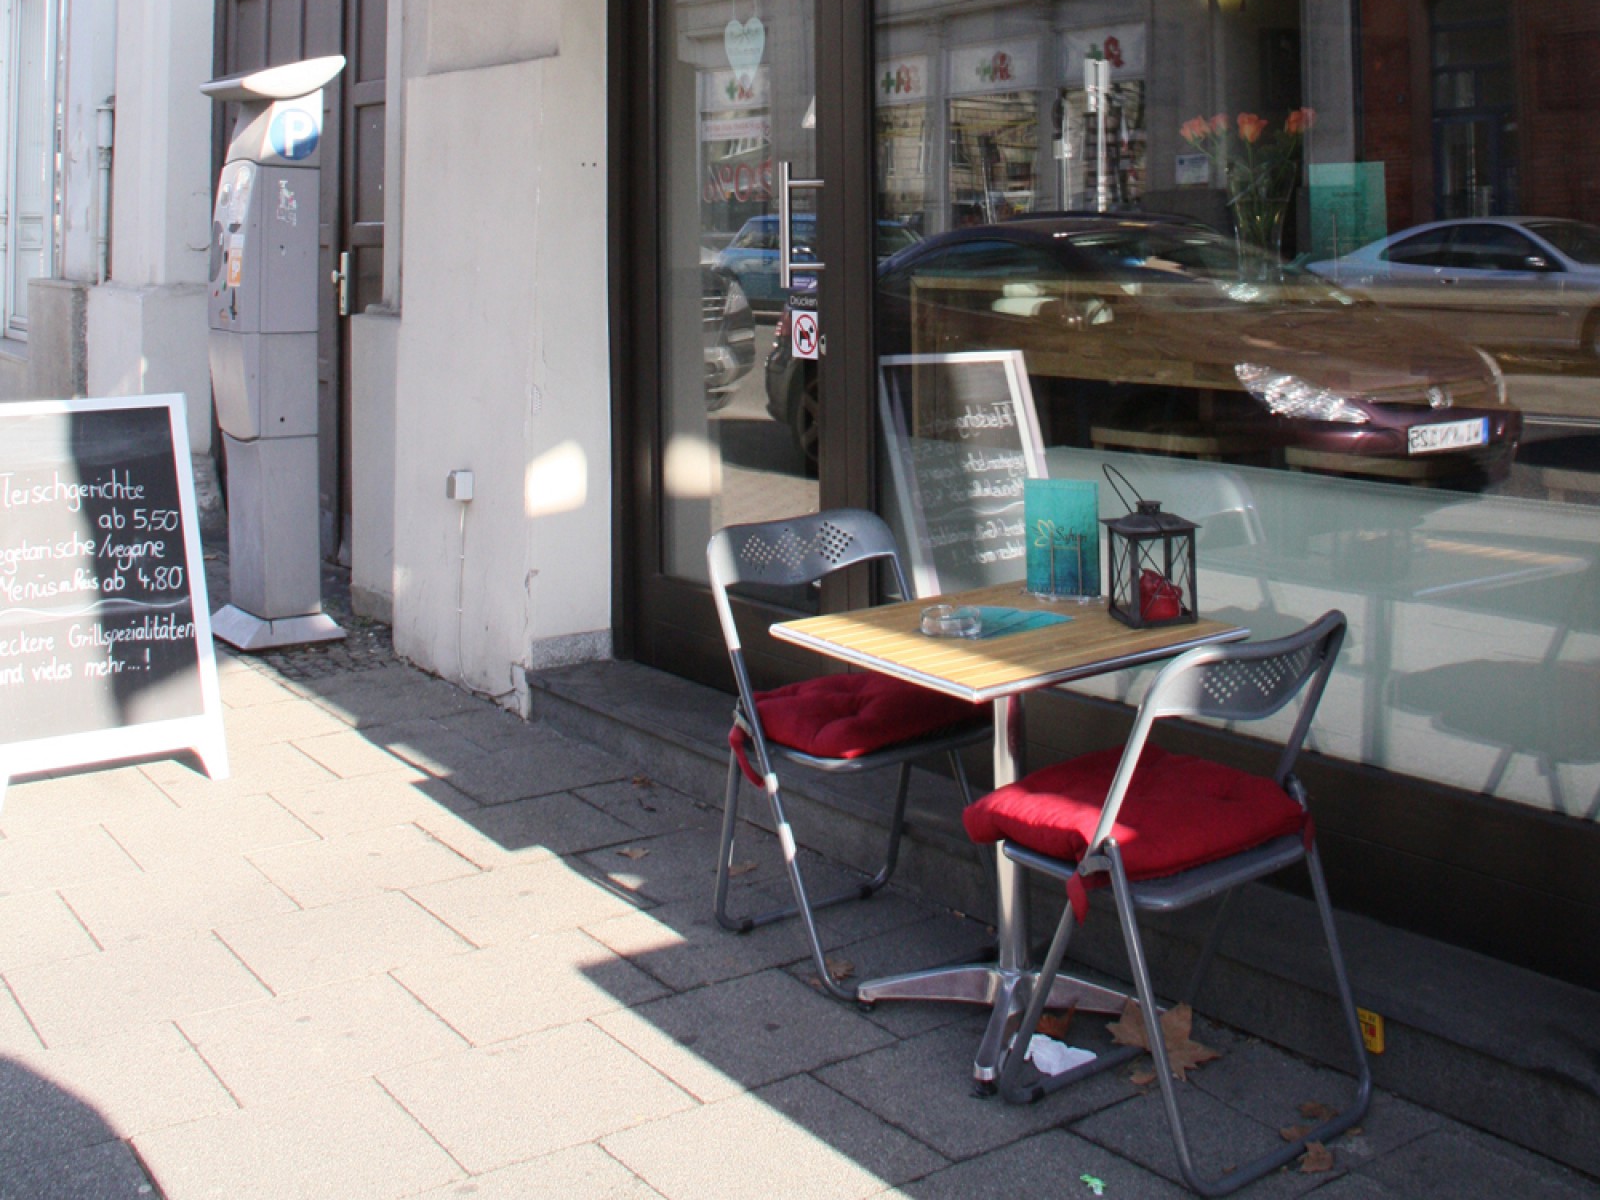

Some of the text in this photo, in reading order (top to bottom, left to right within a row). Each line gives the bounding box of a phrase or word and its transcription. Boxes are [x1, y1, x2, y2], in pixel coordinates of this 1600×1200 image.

[283, 111, 313, 157] P
[0, 469, 145, 511] leischgerichte
[98, 507, 178, 532] ab 5,50
[103, 568, 125, 593] ab
[137, 565, 183, 592] 4,80
[69, 612, 196, 654] Grillspezialitäten
[31, 656, 72, 682] vieles
